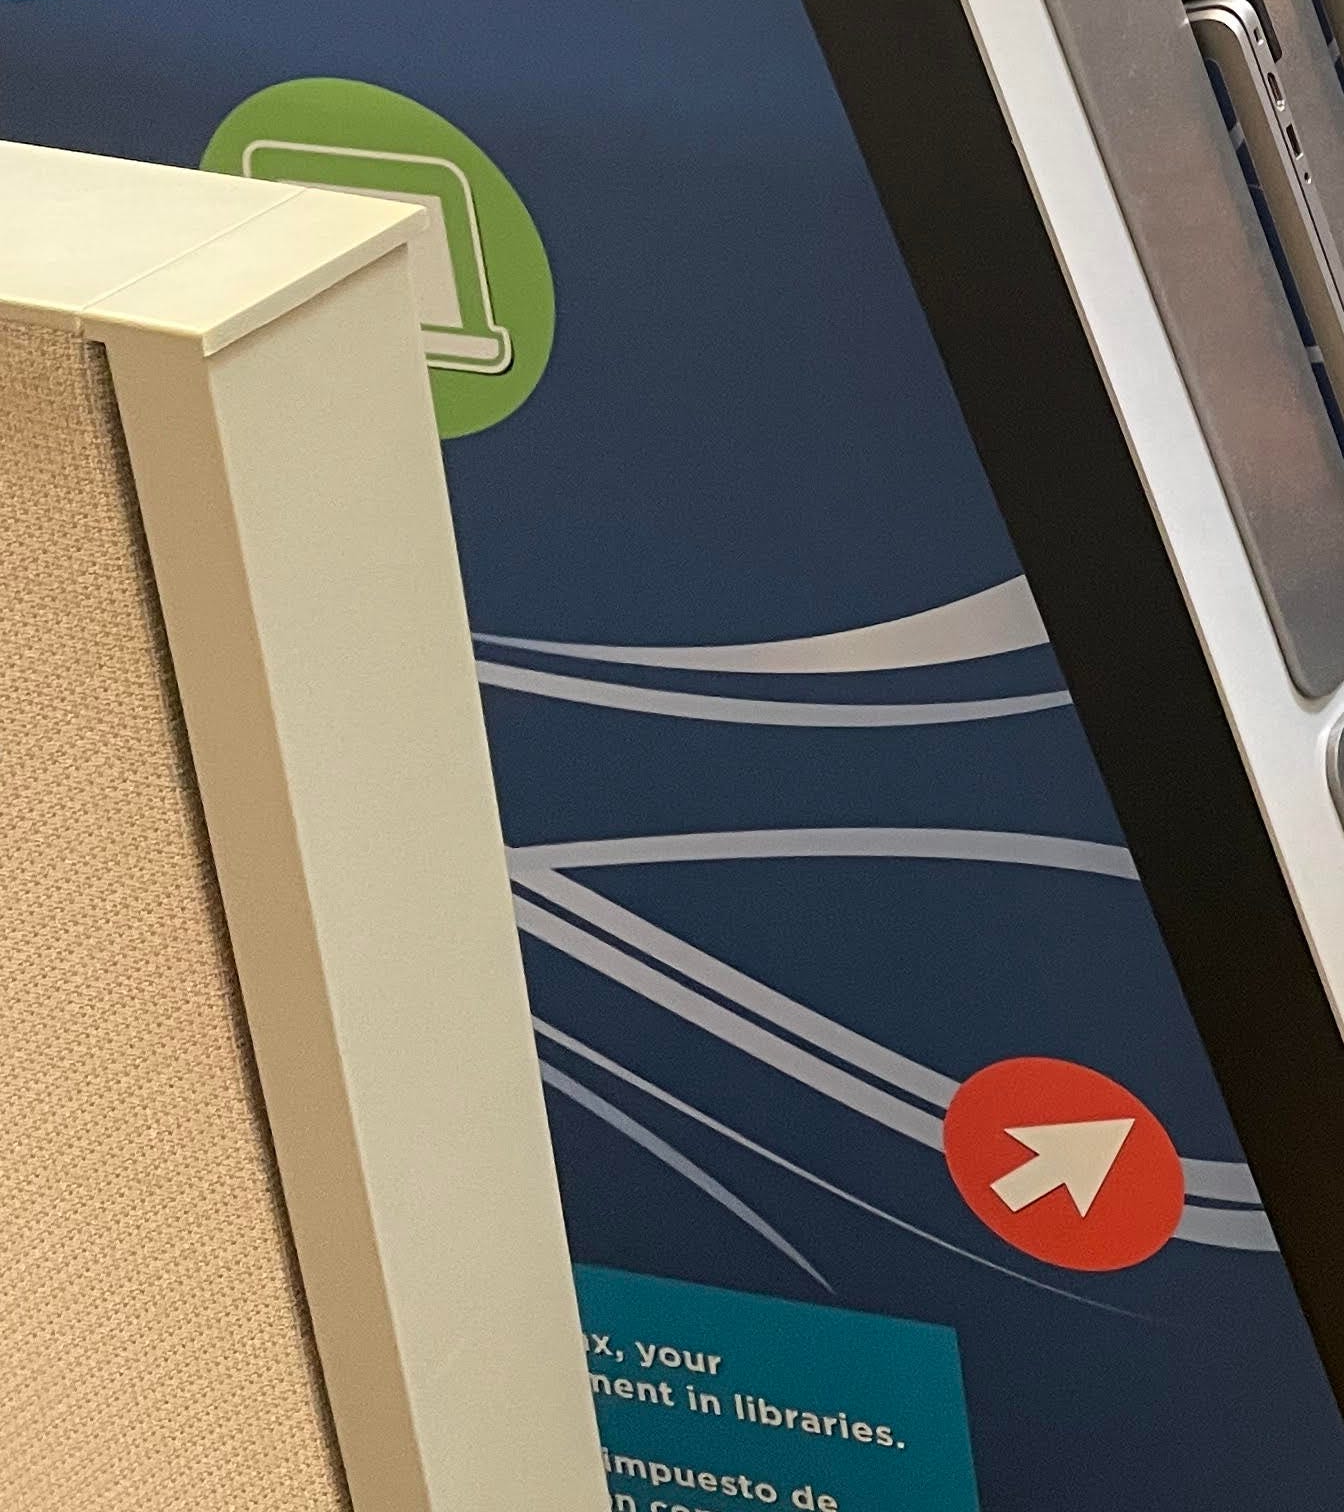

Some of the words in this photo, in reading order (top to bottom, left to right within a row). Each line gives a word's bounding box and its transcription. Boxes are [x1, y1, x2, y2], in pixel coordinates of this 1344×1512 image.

[635, 1341, 723, 1375] your
[687, 1385, 722, 1416] in
[735, 1393, 905, 1449] libraries.
[601, 1447, 777, 1506] impuesto
[791, 1485, 838, 1512] de
